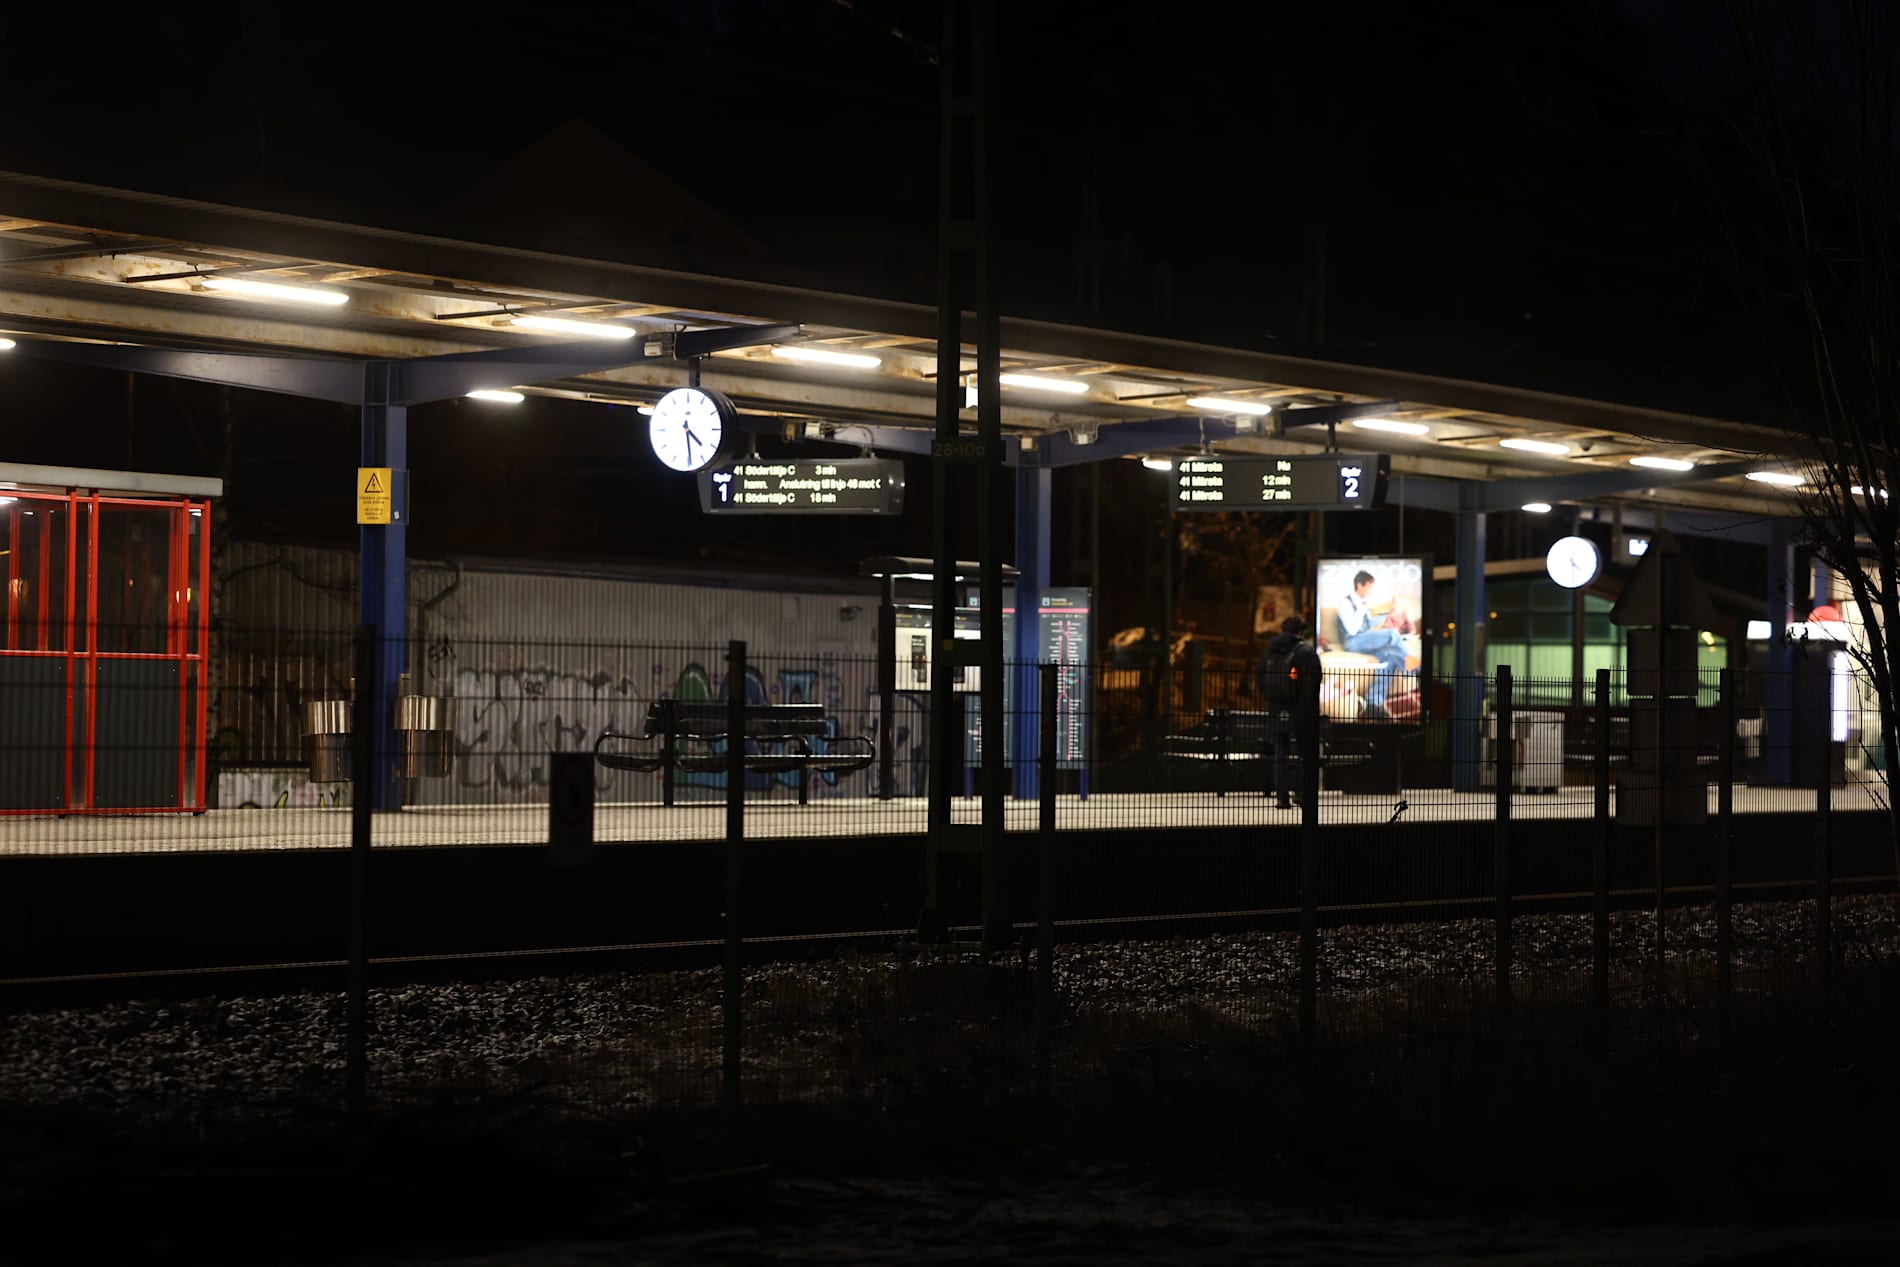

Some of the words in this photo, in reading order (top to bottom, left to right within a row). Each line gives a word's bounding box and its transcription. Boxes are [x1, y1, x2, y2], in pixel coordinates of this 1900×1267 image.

[734, 466, 743, 476] 41
[745, 465, 787, 477] Södertälje
[788, 465, 796, 475] C
[815, 465, 822, 475] 3
[822, 465, 836, 475] min
[1180, 462, 1190, 472] 41
[858, 479, 875, 489] mot
[1180, 476, 1190, 486] 41
[1262, 475, 1275, 485] 12
[1275, 475, 1291, 485] min
[718, 483, 727, 502] 1
[1344, 477, 1359, 498] 2
[734, 493, 743, 503] 41
[745, 493, 787, 505] Södertälje
[787, 493, 795, 503] C
[810, 493, 821, 503] 18
[821, 493, 837, 503] min
[1180, 490, 1190, 500] 41
[1262, 489, 1275, 500] 27
[1275, 489, 1291, 499] min
